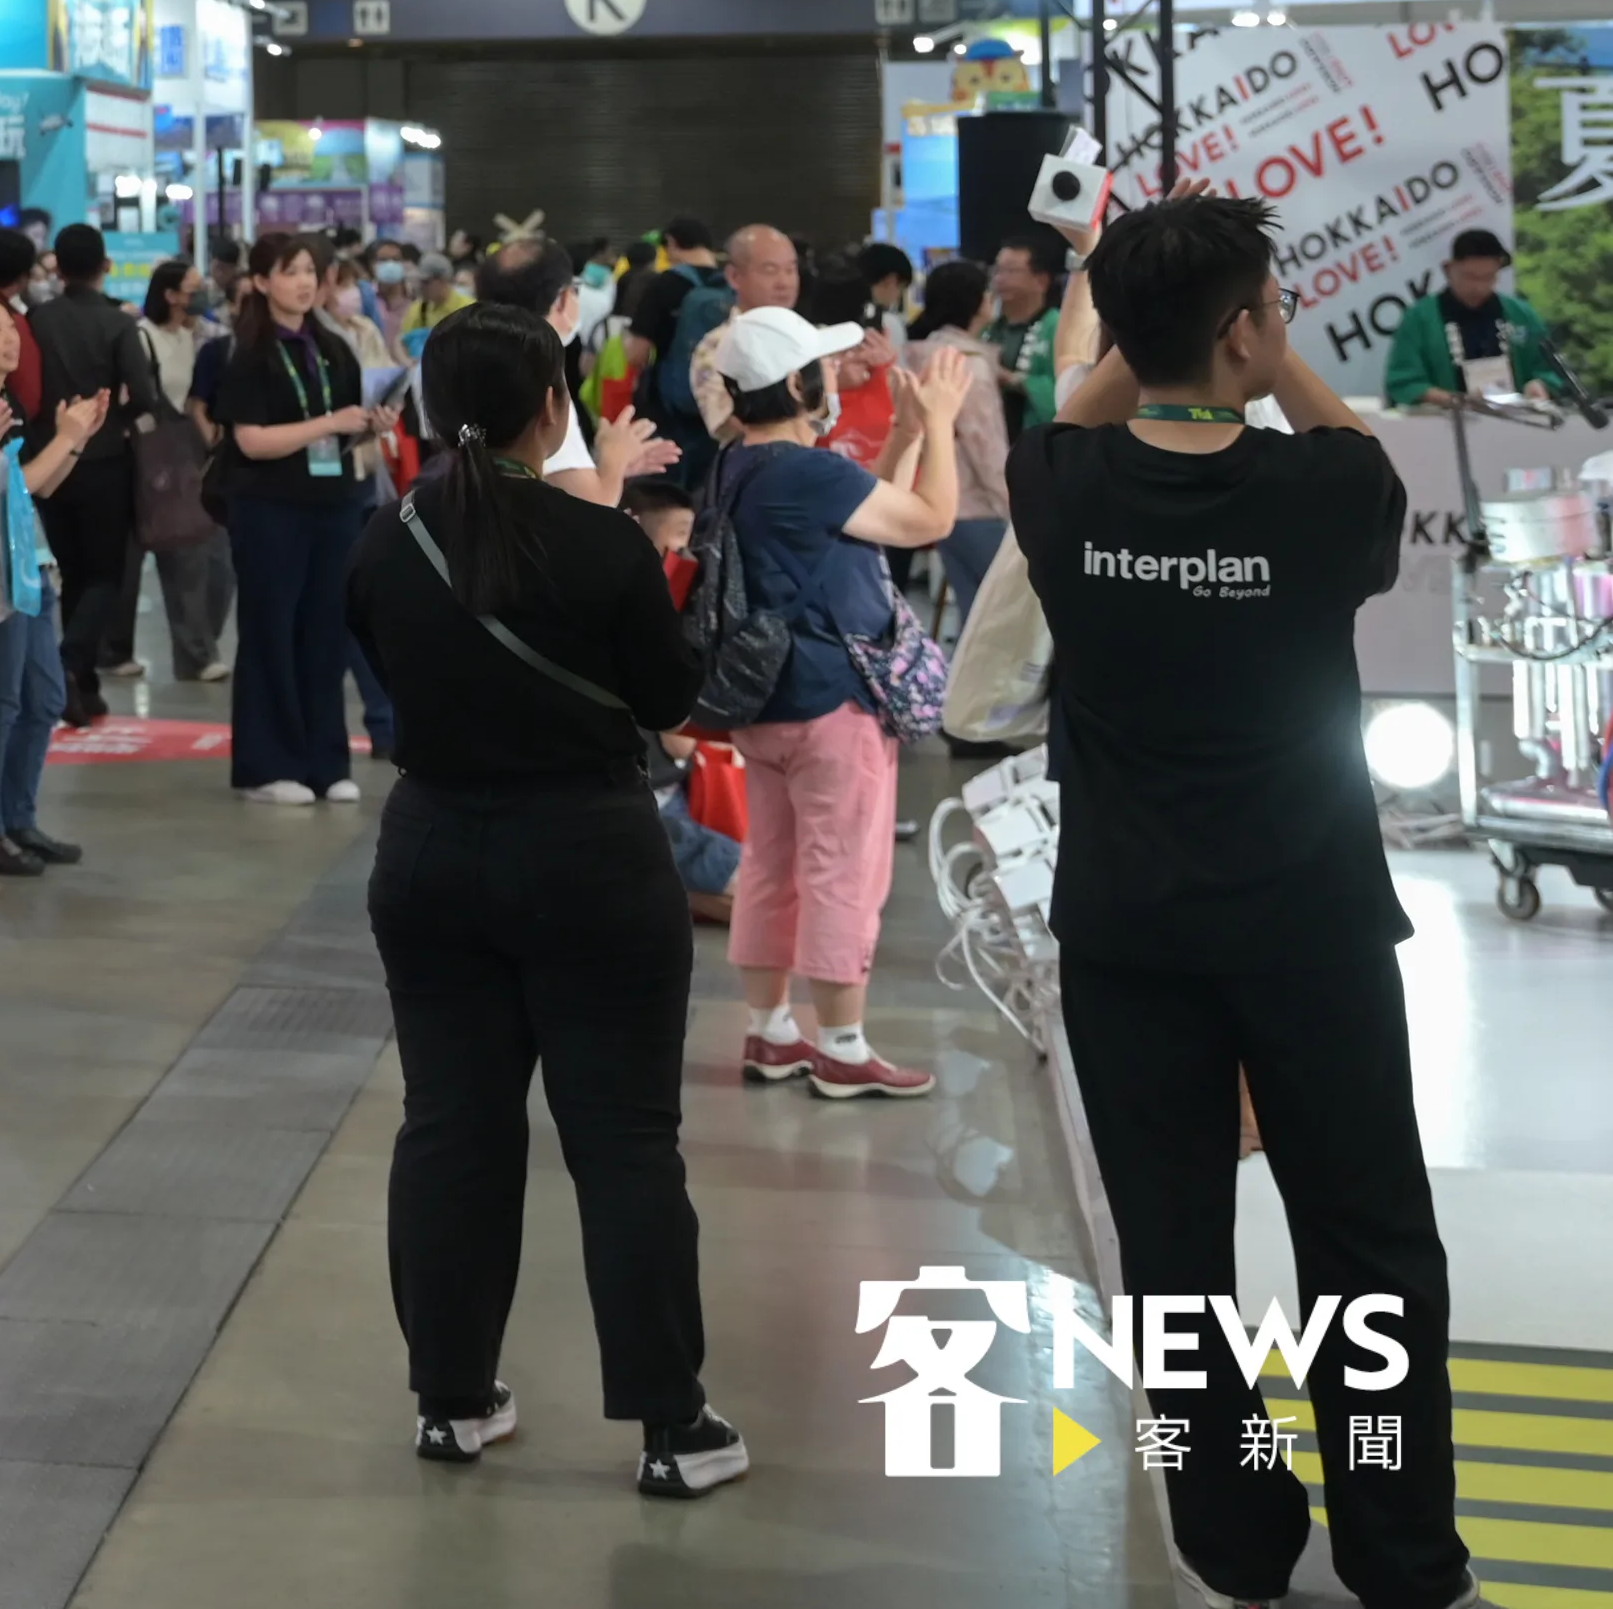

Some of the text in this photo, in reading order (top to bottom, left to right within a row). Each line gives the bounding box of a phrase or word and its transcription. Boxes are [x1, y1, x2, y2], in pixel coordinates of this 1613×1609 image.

[1275, 161, 1459, 278] HOKKAIDO
[1293, 235, 1400, 310] LOVE!
[1084, 541, 1270, 590] interplan
[1192, 584, 1271, 600] Go Beyond
